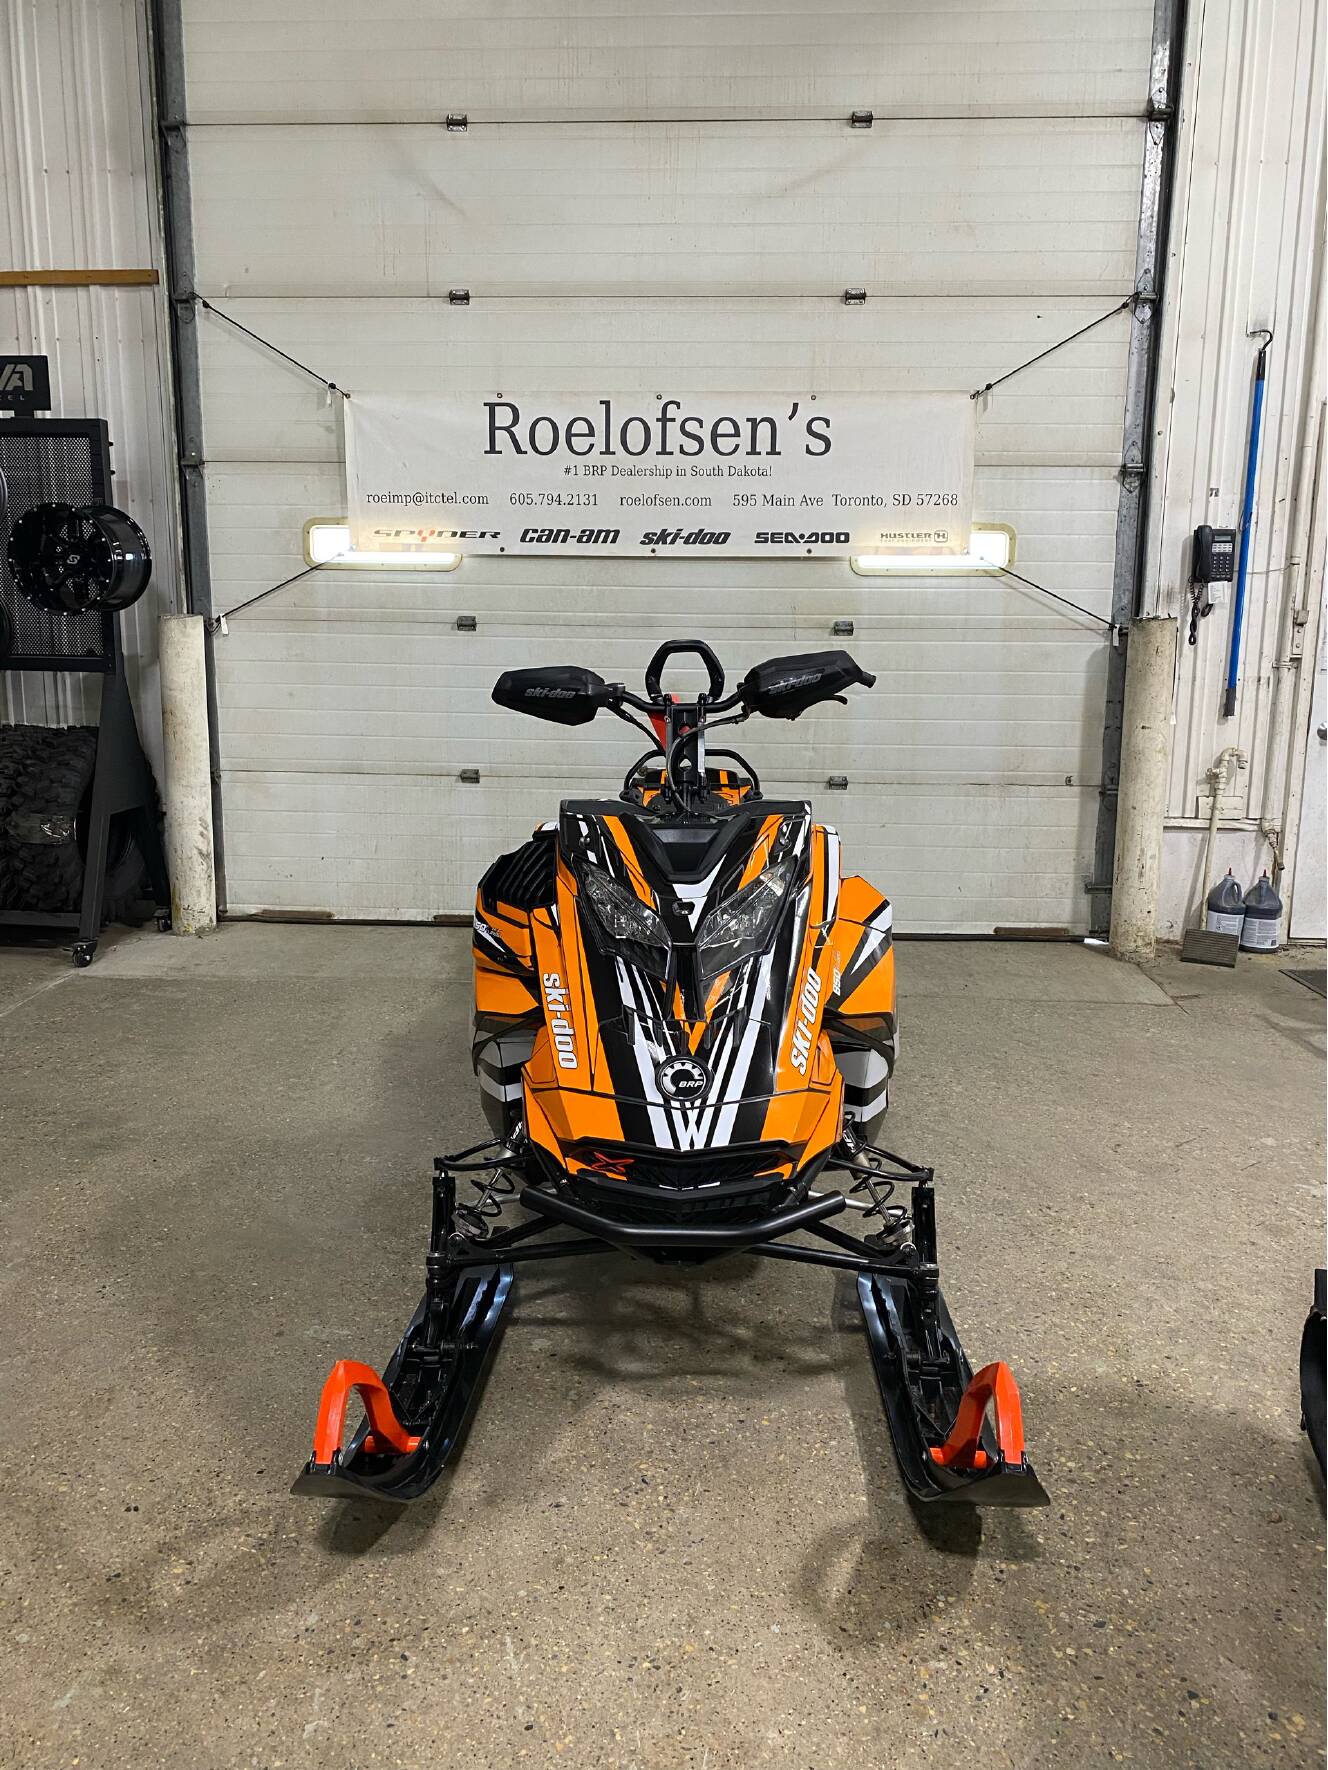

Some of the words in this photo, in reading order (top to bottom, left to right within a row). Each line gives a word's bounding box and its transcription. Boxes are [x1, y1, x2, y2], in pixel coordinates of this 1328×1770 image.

[564, 465, 579, 476] #1
[584, 465, 607, 476] BRP
[611, 464, 672, 479] Dealership
[676, 465, 687, 477] in
[691, 465, 724, 477] South
[728, 465, 772, 477] Dakota!
[366, 491, 489, 507] roeimp@itctel.com
[509, 493, 598, 506] 605.794.2131
[620, 493, 712, 507] roelofsen.com
[733, 494, 757, 507] 595
[762, 494, 795, 507] Main
[800, 494, 824, 507] Ave
[832, 493, 887, 508] Toronto,
[892, 494, 912, 506] SD
[916, 493, 958, 506] 57268
[519, 528, 621, 544] can-am
[678, 1080, 704, 1088] BRP
